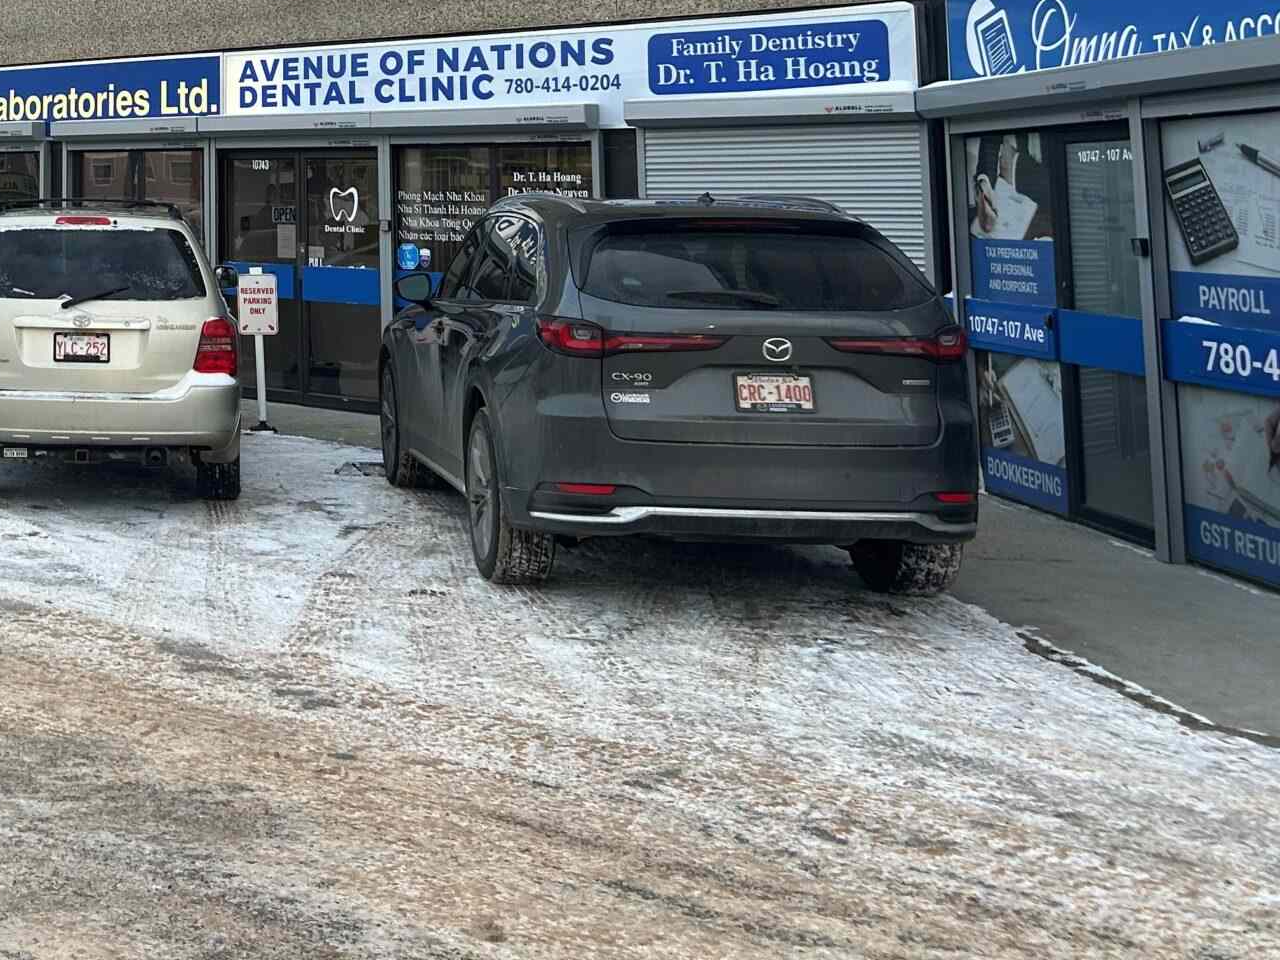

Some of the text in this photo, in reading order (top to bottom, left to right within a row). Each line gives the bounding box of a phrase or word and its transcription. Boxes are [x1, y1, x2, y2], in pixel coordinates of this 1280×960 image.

[672, 30, 861, 59] Family Dentistry
[239, 37, 614, 83] AVENUE OF NATIONS
[657, 56, 880, 86] Dr. T. Ha Hoang
[160, 78, 218, 114] Ltd.
[239, 74, 622, 109] DENTAL CLINIC 780-414-0204
[1078, 150, 1100, 162] 10747
[1107, 148, 1120, 161] 107
[513, 171, 582, 185] Dr. T. Ha Hoang
[273, 207, 296, 222] OPEN
[325, 224, 366, 233] Dental Clinic
[240, 287, 274, 295] RESERVED
[243, 297, 272, 305] PARKING
[1199, 285, 1271, 315] PAYROLL
[250, 307, 266, 315] ONLY
[969, 315, 1045, 343] 10747-107 Ave
[1202, 340, 1280, 381] 780-4
[611, 372, 652, 381] CX-90
[739, 383, 811, 402] CRC-1400
[986, 455, 1062, 497] BOOKKEEPING
[1200, 520, 1231, 551] GST
